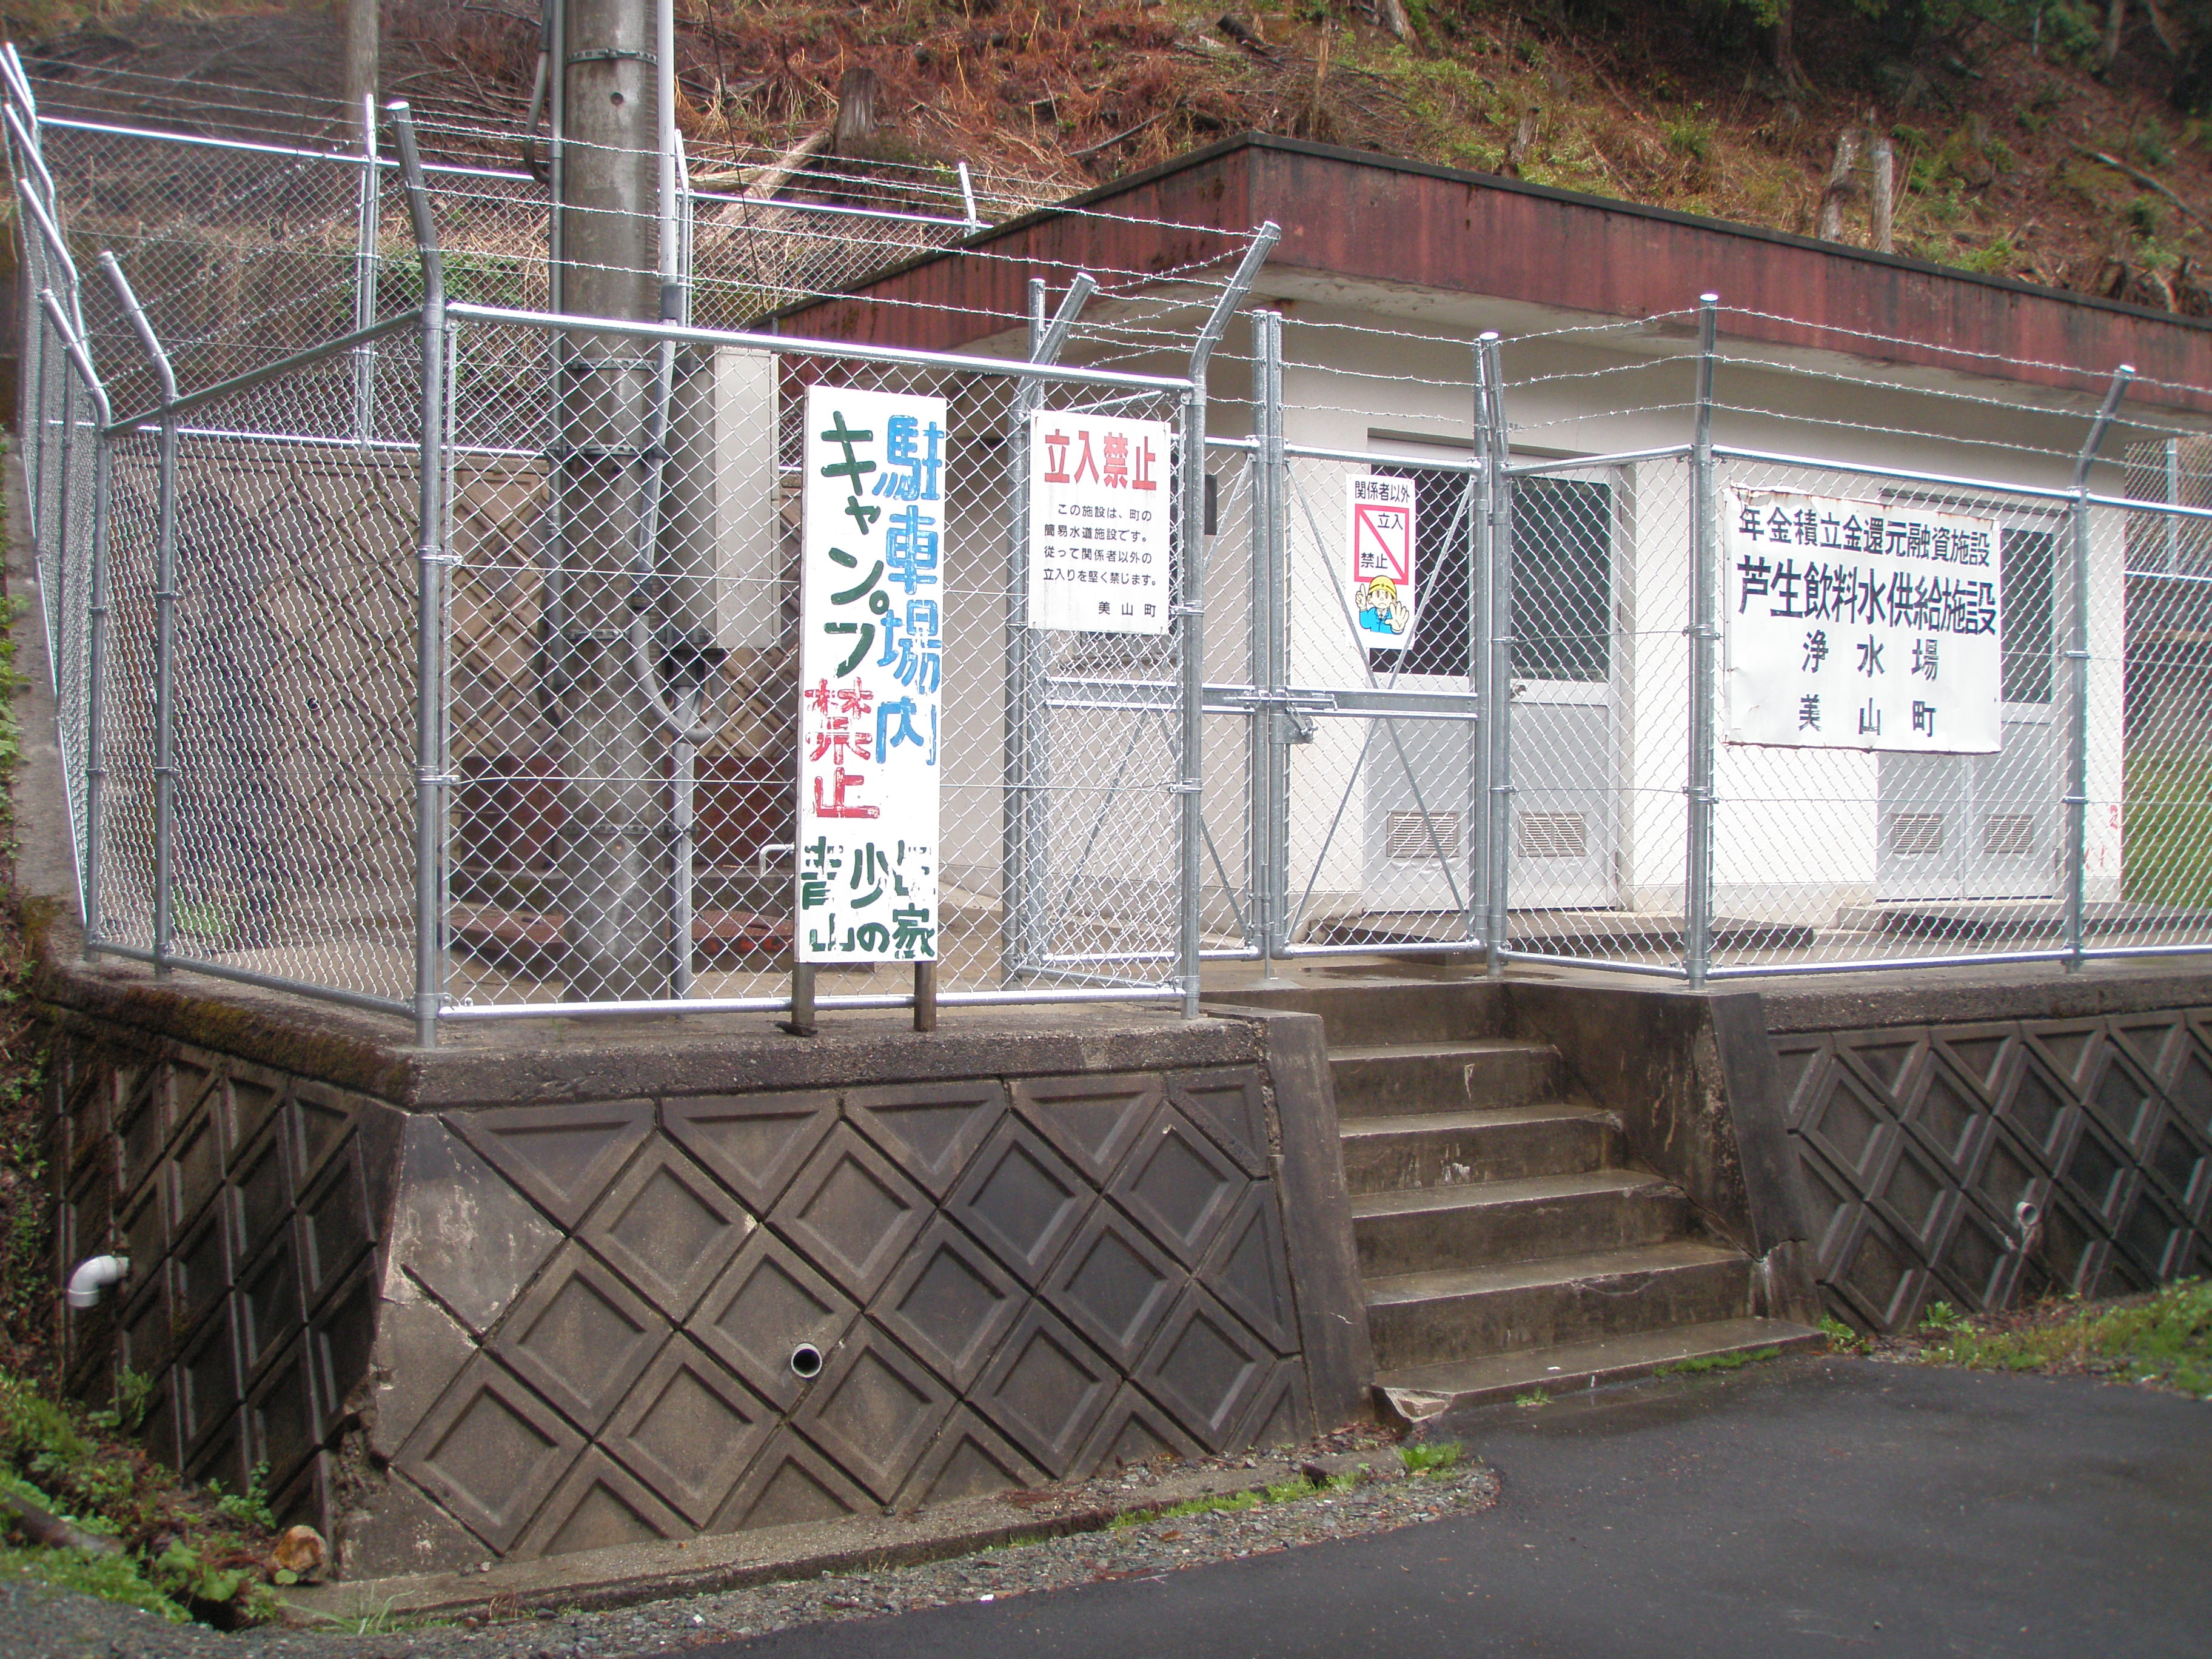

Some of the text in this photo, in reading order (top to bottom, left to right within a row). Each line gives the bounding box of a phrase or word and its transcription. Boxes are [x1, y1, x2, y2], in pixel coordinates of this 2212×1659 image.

[1044, 429, 1156, 491] 立入禁止
[1355, 480, 1410, 503] 関係者以外
[1057, 504, 1151, 522] この施設は、町の
[1377, 512, 1403, 530] 立入
[1044, 524, 1147, 543] 簡易水道施設です。
[1738, 505, 1991, 567] 年金積立金還元融資施設
[1044, 545, 1151, 565] 従って関係者以外の
[1361, 552, 1388, 569] 禁止
[1043, 568, 1156, 586] 立入りを堅く禁じます。
[872, 415, 945, 765] 駐車場内
[1737, 554, 1996, 635] 芦生飲料水供給施設
